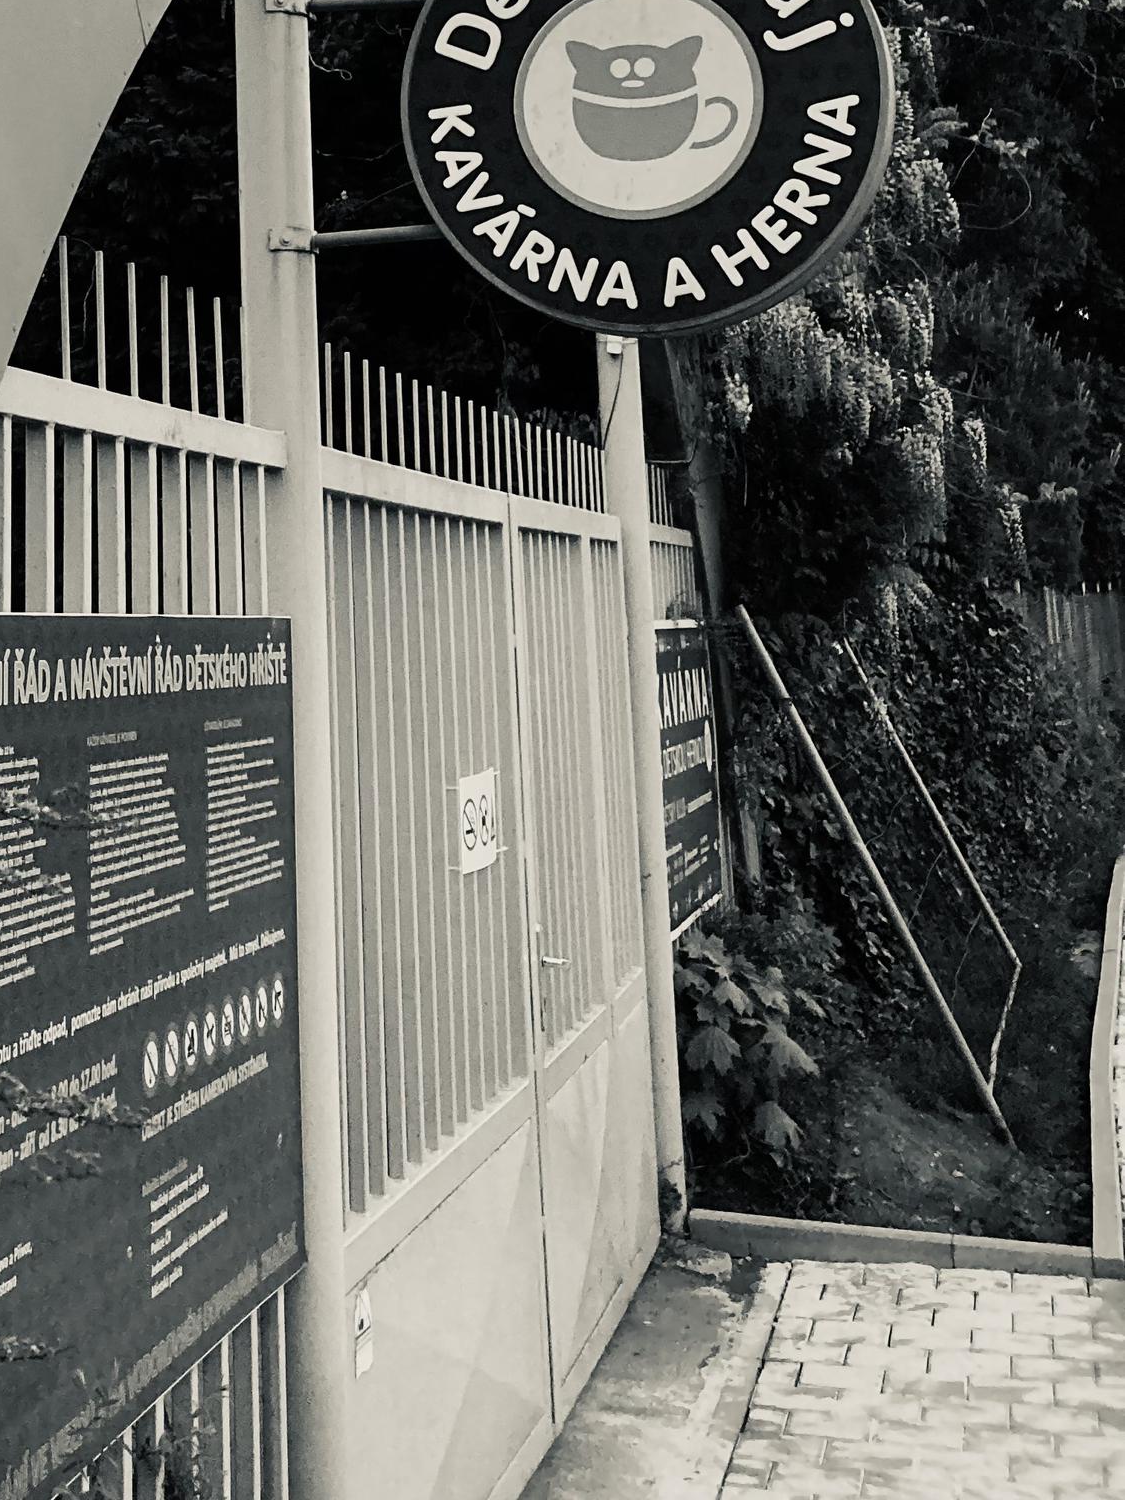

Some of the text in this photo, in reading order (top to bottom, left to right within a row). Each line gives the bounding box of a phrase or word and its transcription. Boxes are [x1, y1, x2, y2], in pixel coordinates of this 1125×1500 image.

[428, 94, 860, 309] KAVÁRNA A HERNA
[14, 648, 50, 705] ŘÁD
[54, 659, 67, 701] A
[71, 646, 153, 700] NÁVŠTĚVNÍ
[155, 645, 182, 693] ŘÁD
[186, 644, 247, 690] DĚTSKÉHO
[249, 643, 287, 686] HŘIŠTĚ
[659, 655, 709, 729] AVÁRNA
[13, 1042, 18, 1058] a
[43, 1015, 68, 1045] odpad,
[71, 1004, 101, 1036] pomozte
